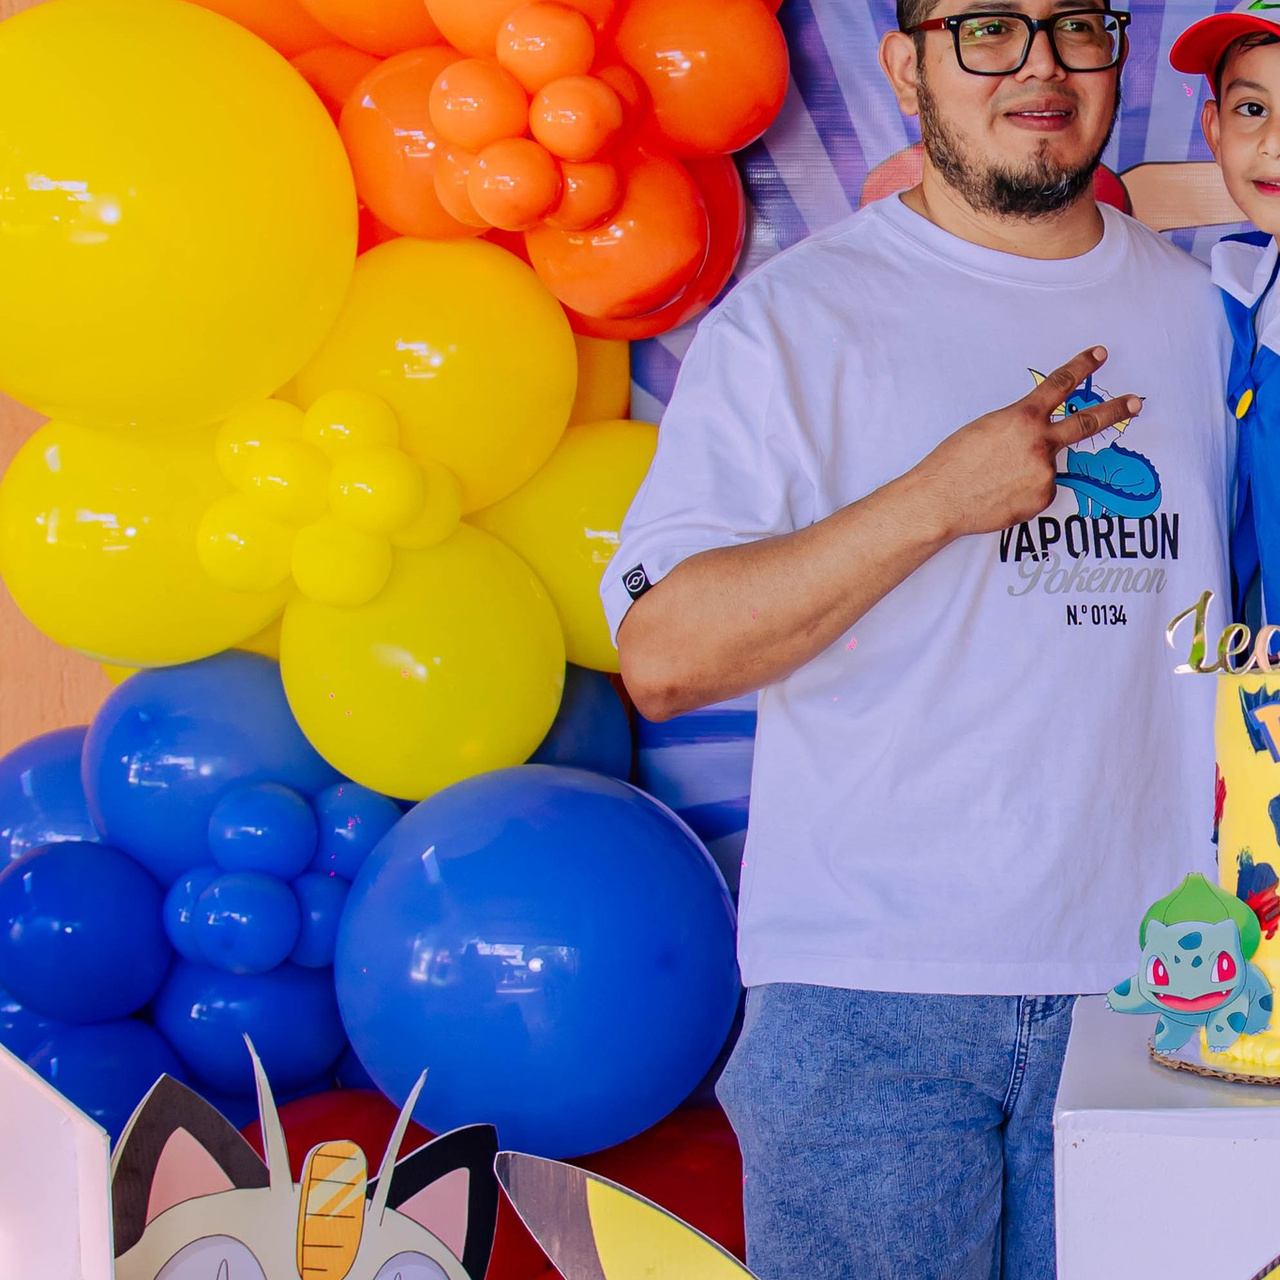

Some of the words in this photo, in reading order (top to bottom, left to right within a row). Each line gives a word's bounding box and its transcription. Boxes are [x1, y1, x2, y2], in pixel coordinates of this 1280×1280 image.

[1000, 513, 1179, 562] VAPOREON
[1007, 550, 1167, 597] Pokémon
[1092, 604, 1127, 625] 0134
